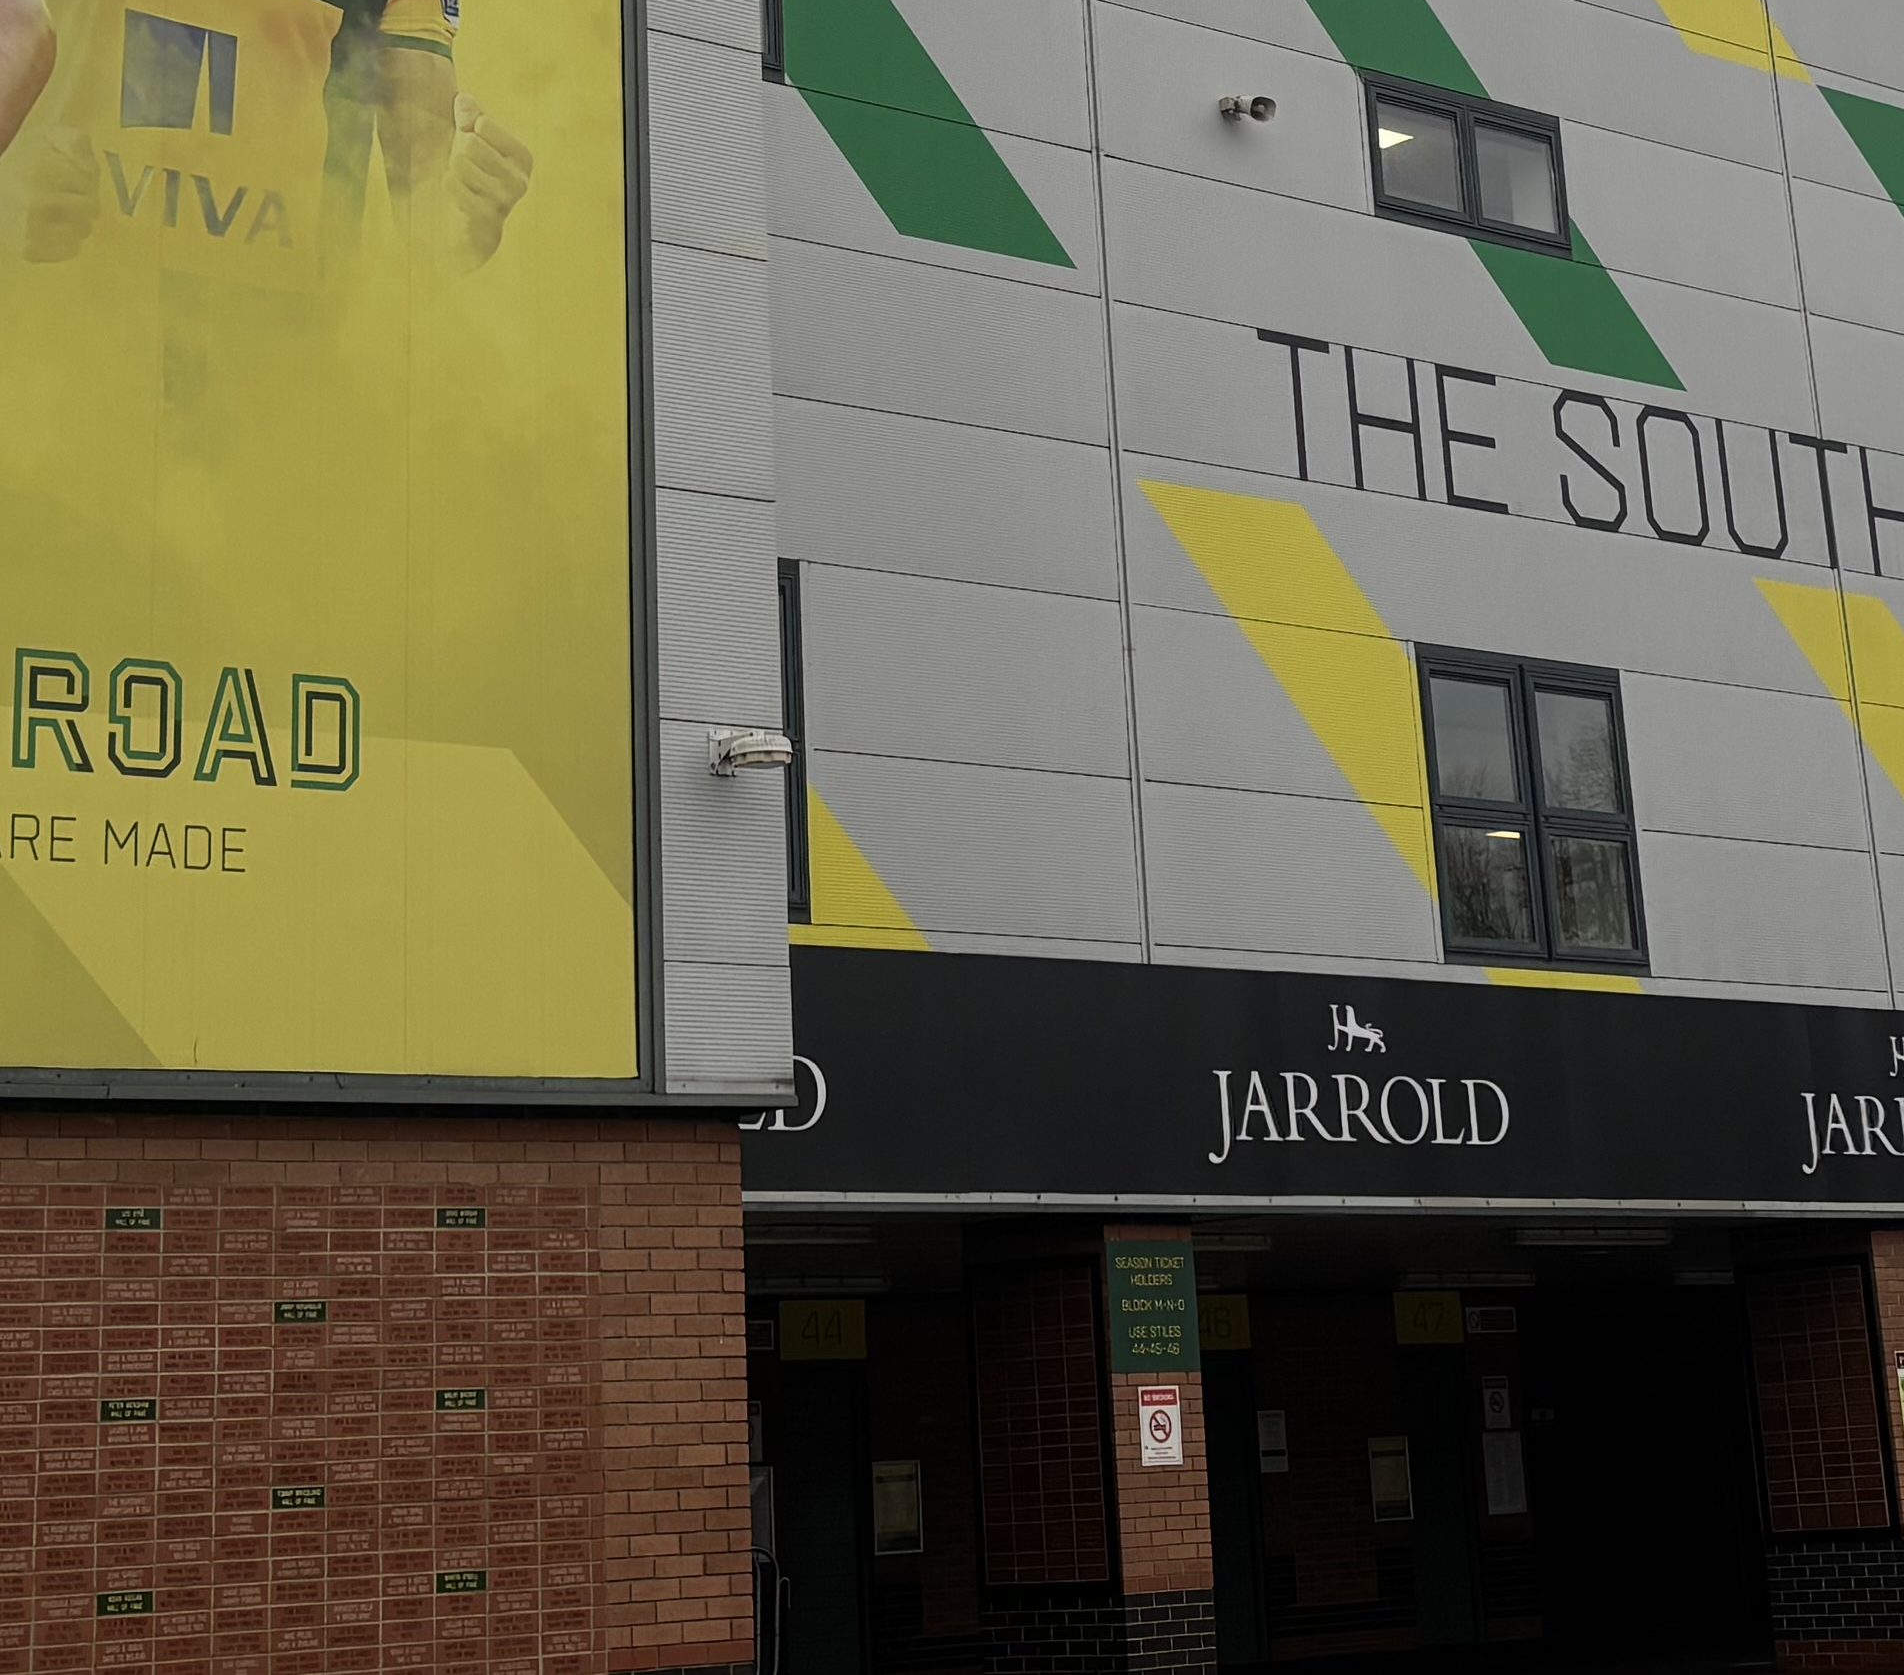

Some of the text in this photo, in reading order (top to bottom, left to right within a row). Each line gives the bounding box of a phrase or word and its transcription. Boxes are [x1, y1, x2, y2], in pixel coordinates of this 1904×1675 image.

[1258, 329, 1509, 515] THE
[11, 647, 360, 792] ROAD
[103, 818, 247, 873] MADE
[1207, 1069, 1510, 1165] JARROLD
[1115, 1256, 1184, 1269] SEASON TICKET
[1130, 1274, 1173, 1285] HOLDERS
[1122, 1299, 1152, 1311] BLOCK
[1412, 1301, 1444, 1326] 47
[801, 1310, 842, 1346] 44
[1128, 1325, 1182, 1338] USE STILES
